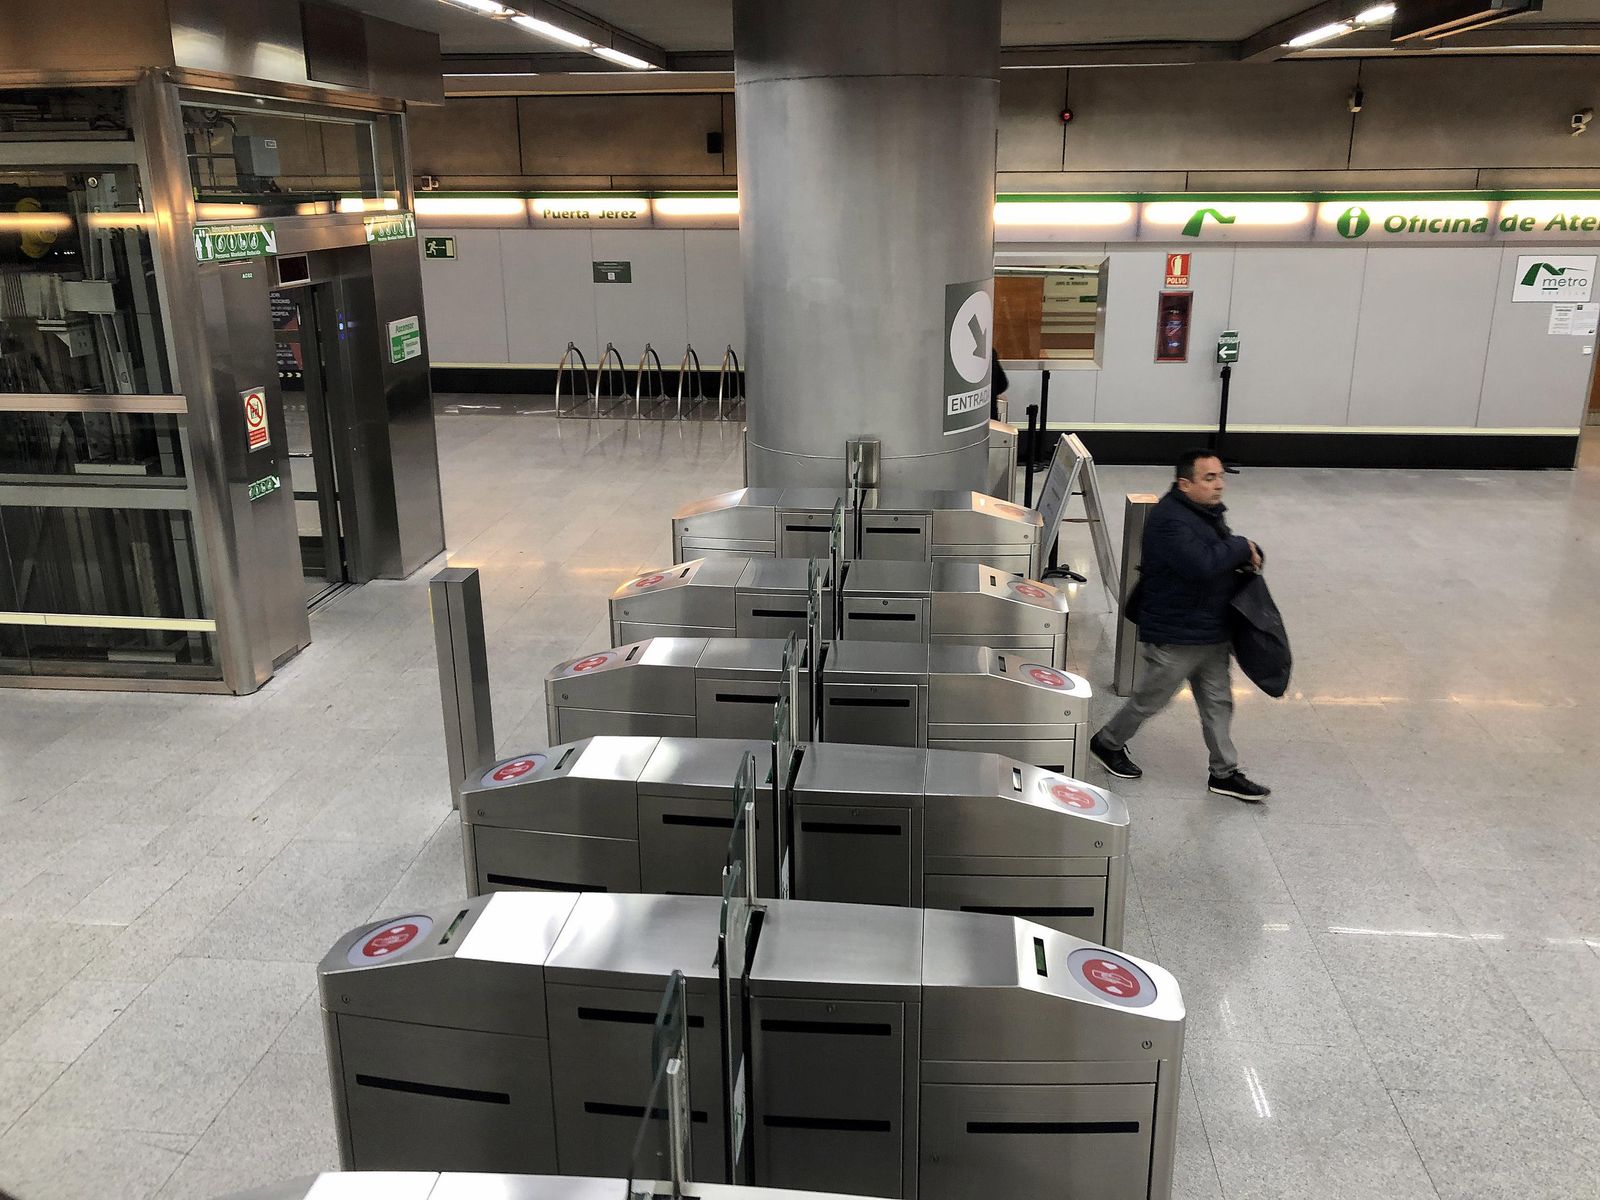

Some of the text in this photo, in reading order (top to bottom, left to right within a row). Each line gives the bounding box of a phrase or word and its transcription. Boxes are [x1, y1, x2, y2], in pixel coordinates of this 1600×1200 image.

[543, 209, 637, 219] Puerta Jerez
[1383, 214, 1489, 233] Oficina
[1500, 214, 1536, 232] de
[1542, 277, 1588, 287] metro
